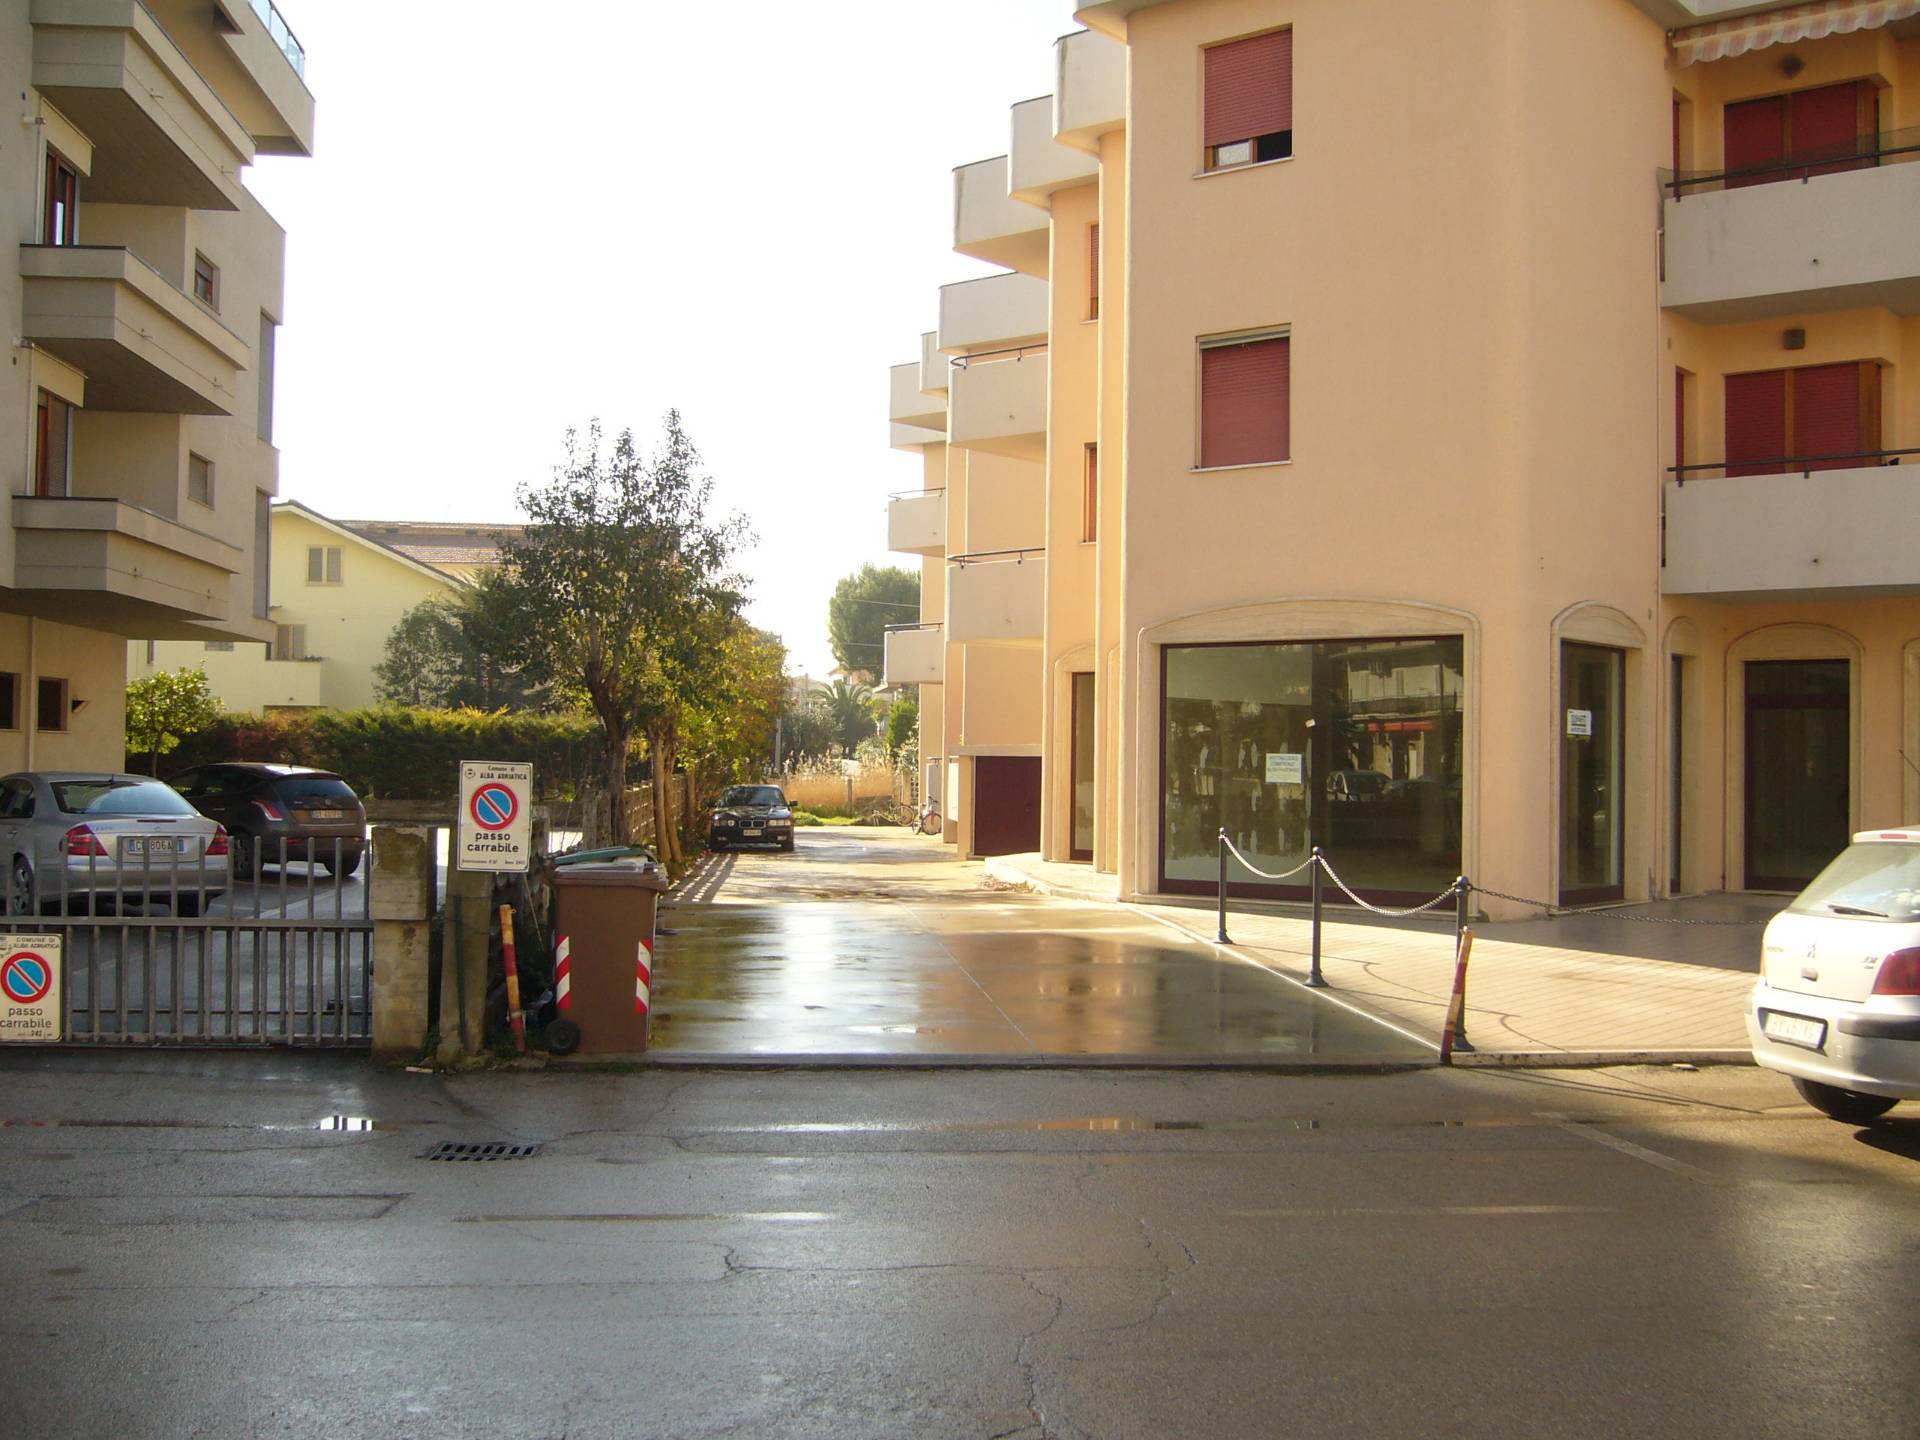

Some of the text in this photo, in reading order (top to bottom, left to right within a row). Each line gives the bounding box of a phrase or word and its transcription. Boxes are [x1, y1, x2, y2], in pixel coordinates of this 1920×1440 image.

[475, 832, 511, 842] passo
[467, 842, 519, 853] carrabile
[8, 1007, 43, 1017] passo
[0, 1018, 52, 1029] carrabile
